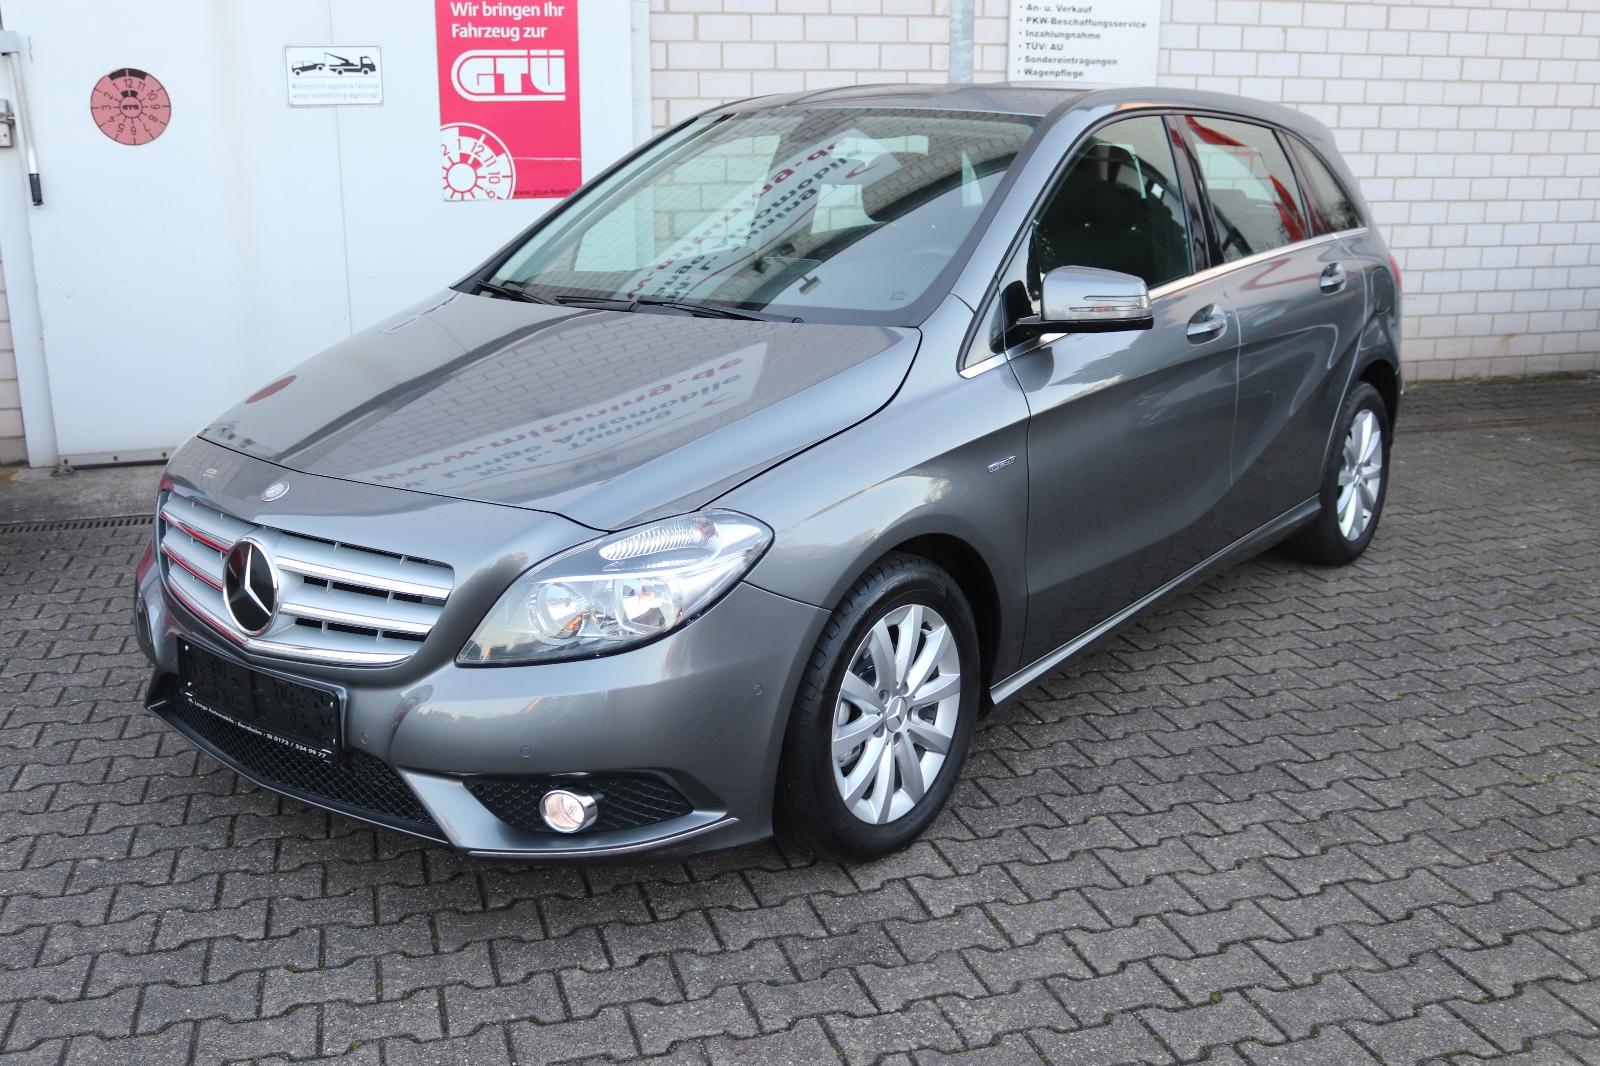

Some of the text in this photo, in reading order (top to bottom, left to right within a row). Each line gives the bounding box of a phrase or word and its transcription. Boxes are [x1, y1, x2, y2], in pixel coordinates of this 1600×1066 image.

[450, 2, 565, 21] Wir bringen Ihr
[1026, 4, 1042, 12] An-
[1056, 5, 1093, 13] Verkauf
[1026, 17, 1147, 29] PKW-Beschaffungsservice
[451, 22, 547, 41] Fahrzeug zur
[1025, 30, 1101, 40] Inzahlungnahme
[1050, 43, 1064, 51] AU
[1024, 55, 1118, 66] Sondereintragungen
[451, 49, 566, 102] GTÜ
[1024, 68, 1084, 78] Wagenpflege
[113, 82, 120, 91] 1
[124, 78, 133, 89] 12
[136, 81, 146, 91] 11
[103, 91, 114, 100] 2
[146, 89, 158, 101] 10
[148, 114, 158, 123] 8
[117, 123, 126, 133] 5
[130, 127, 137, 136] 6
[457, 139, 462, 150] 1
[470, 142, 485, 156] 12
[485, 155, 498, 168] 11
[488, 172, 501, 184] 10
[273, 736, 289, 746] 0173
